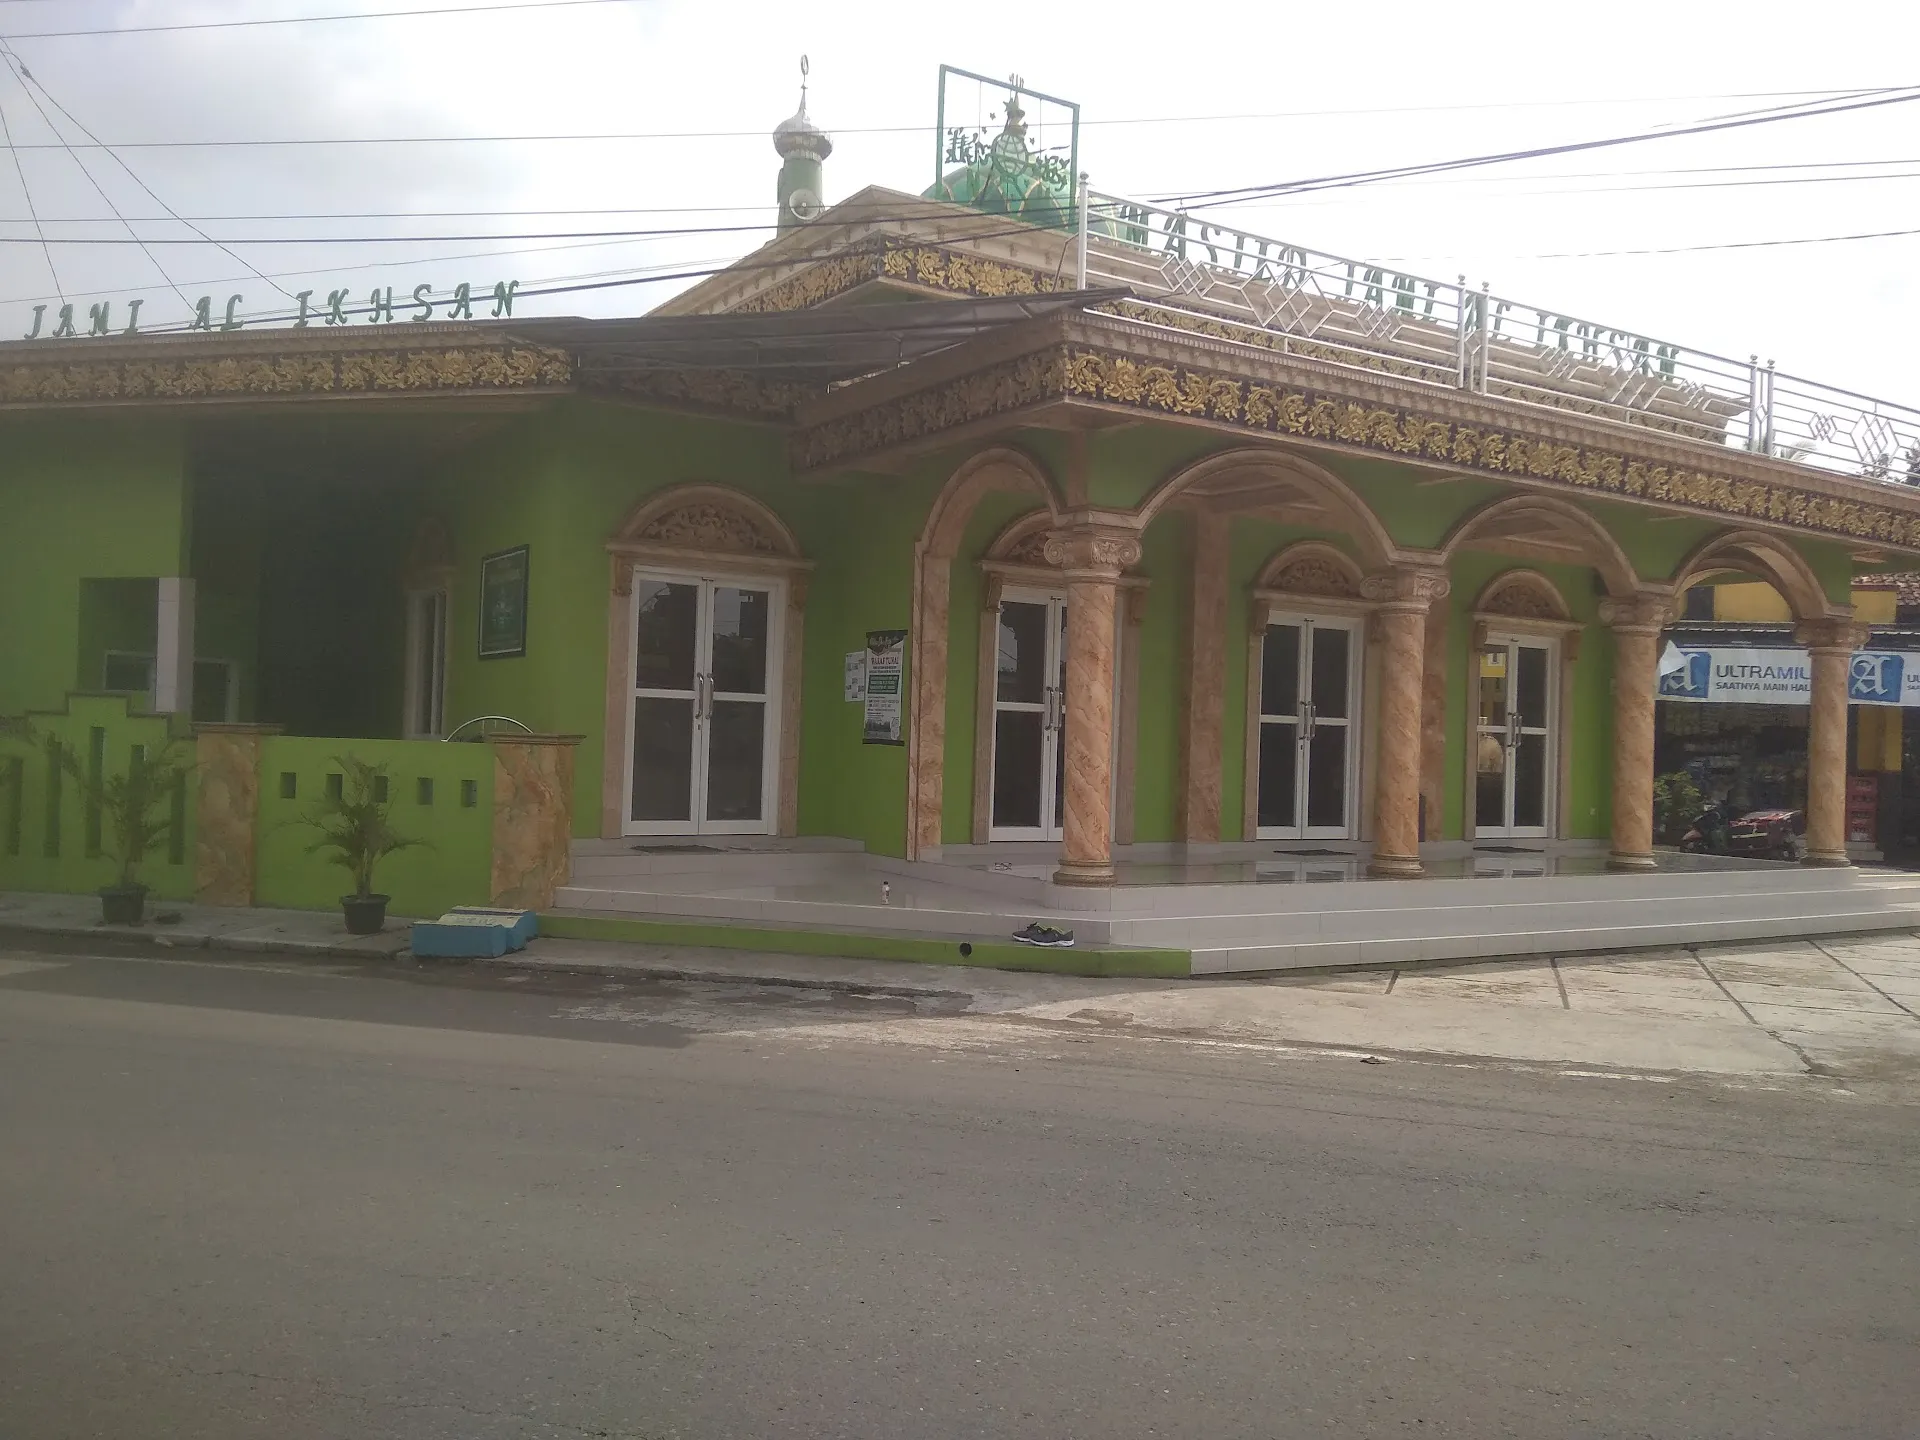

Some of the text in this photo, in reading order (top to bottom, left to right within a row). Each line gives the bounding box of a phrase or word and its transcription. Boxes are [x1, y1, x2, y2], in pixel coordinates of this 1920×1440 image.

[24, 280, 519, 339] JAMI AL IKHSAN
[1716, 664, 1811, 680] ULTRAMIL
[1716, 681, 1760, 691] SAATNYA
[1763, 683, 1788, 692] MAIN
